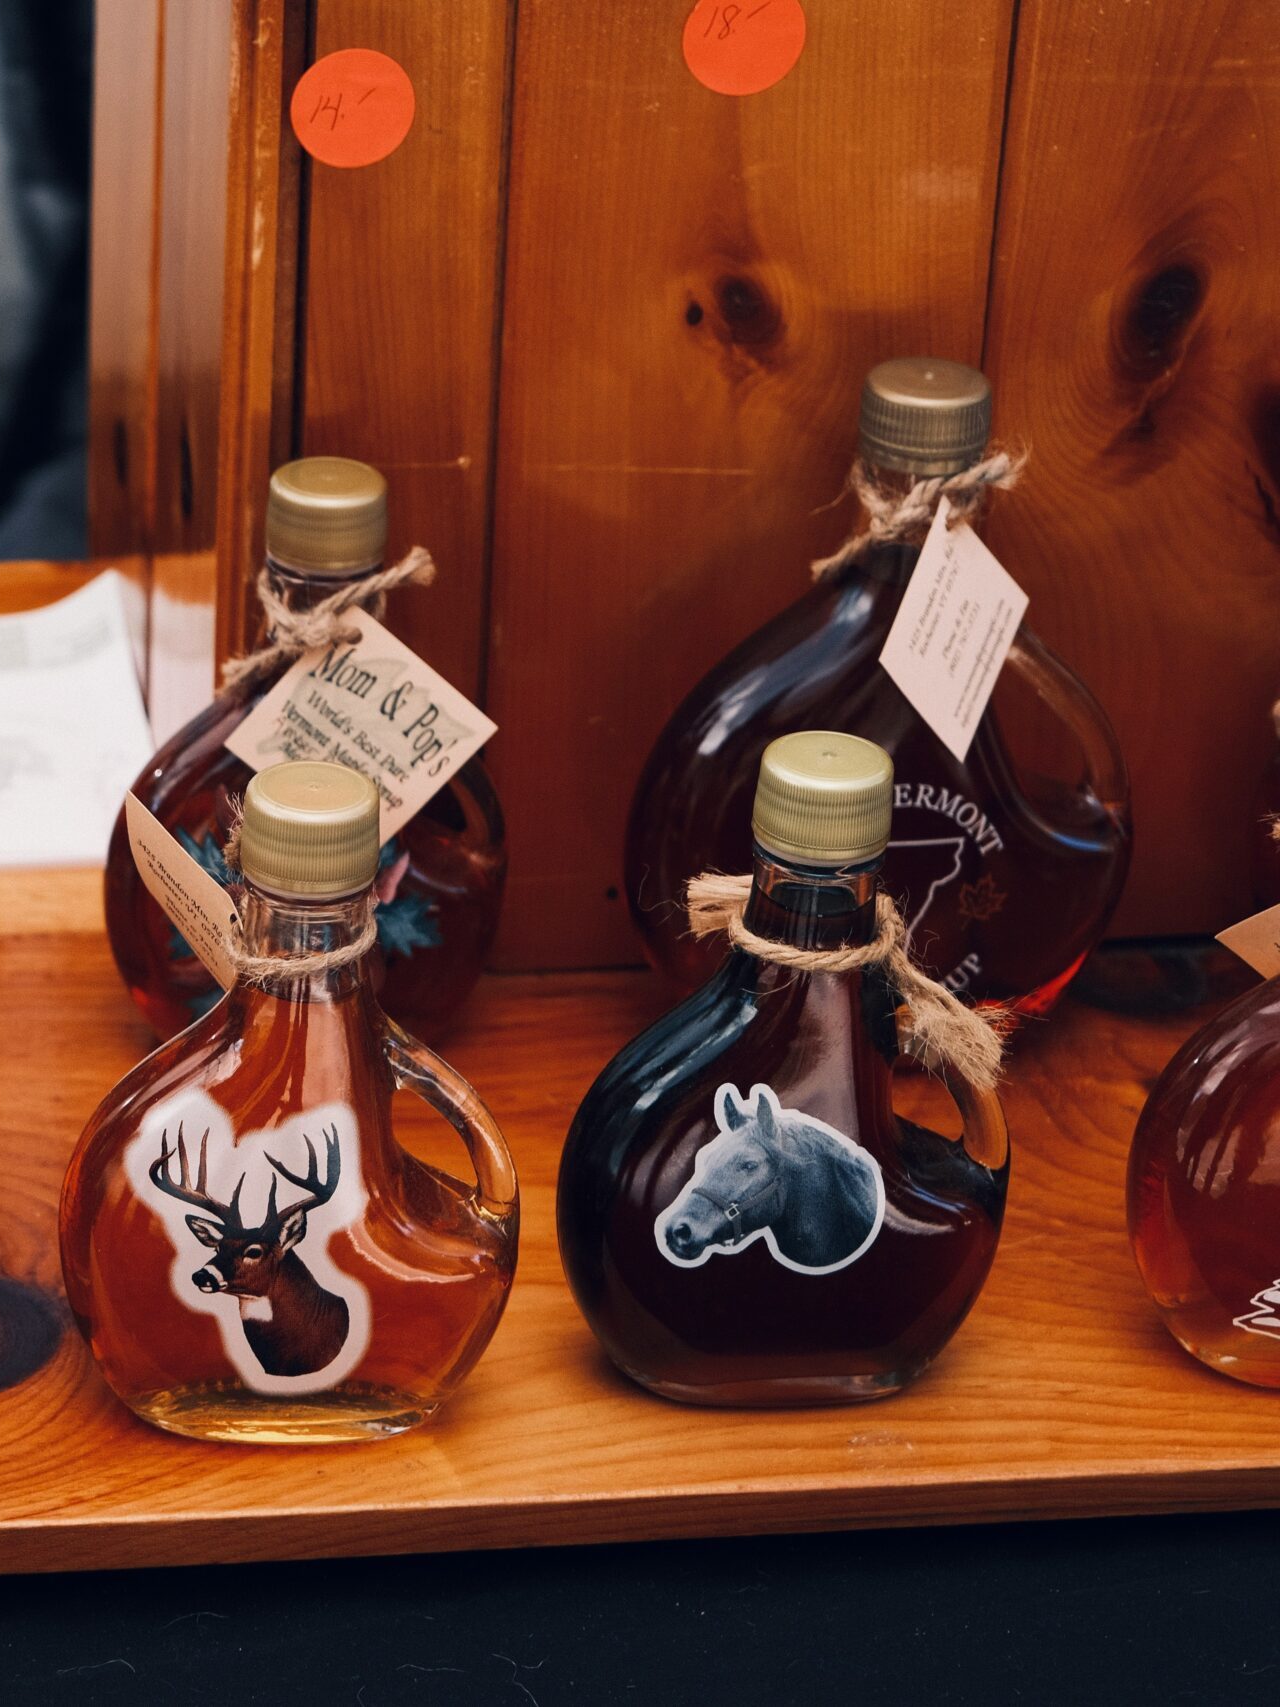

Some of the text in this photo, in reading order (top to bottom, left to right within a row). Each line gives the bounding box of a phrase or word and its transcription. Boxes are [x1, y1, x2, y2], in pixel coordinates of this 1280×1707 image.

[282, 700, 331, 747] Vermont
[307, 689, 410, 783] World's Best Pure
[308, 643, 459, 778] Mom & Pop's
[893, 782, 1004, 854] ERMONT
[156, 860, 191, 903] Brandon
[186, 905, 200, 920] VT
